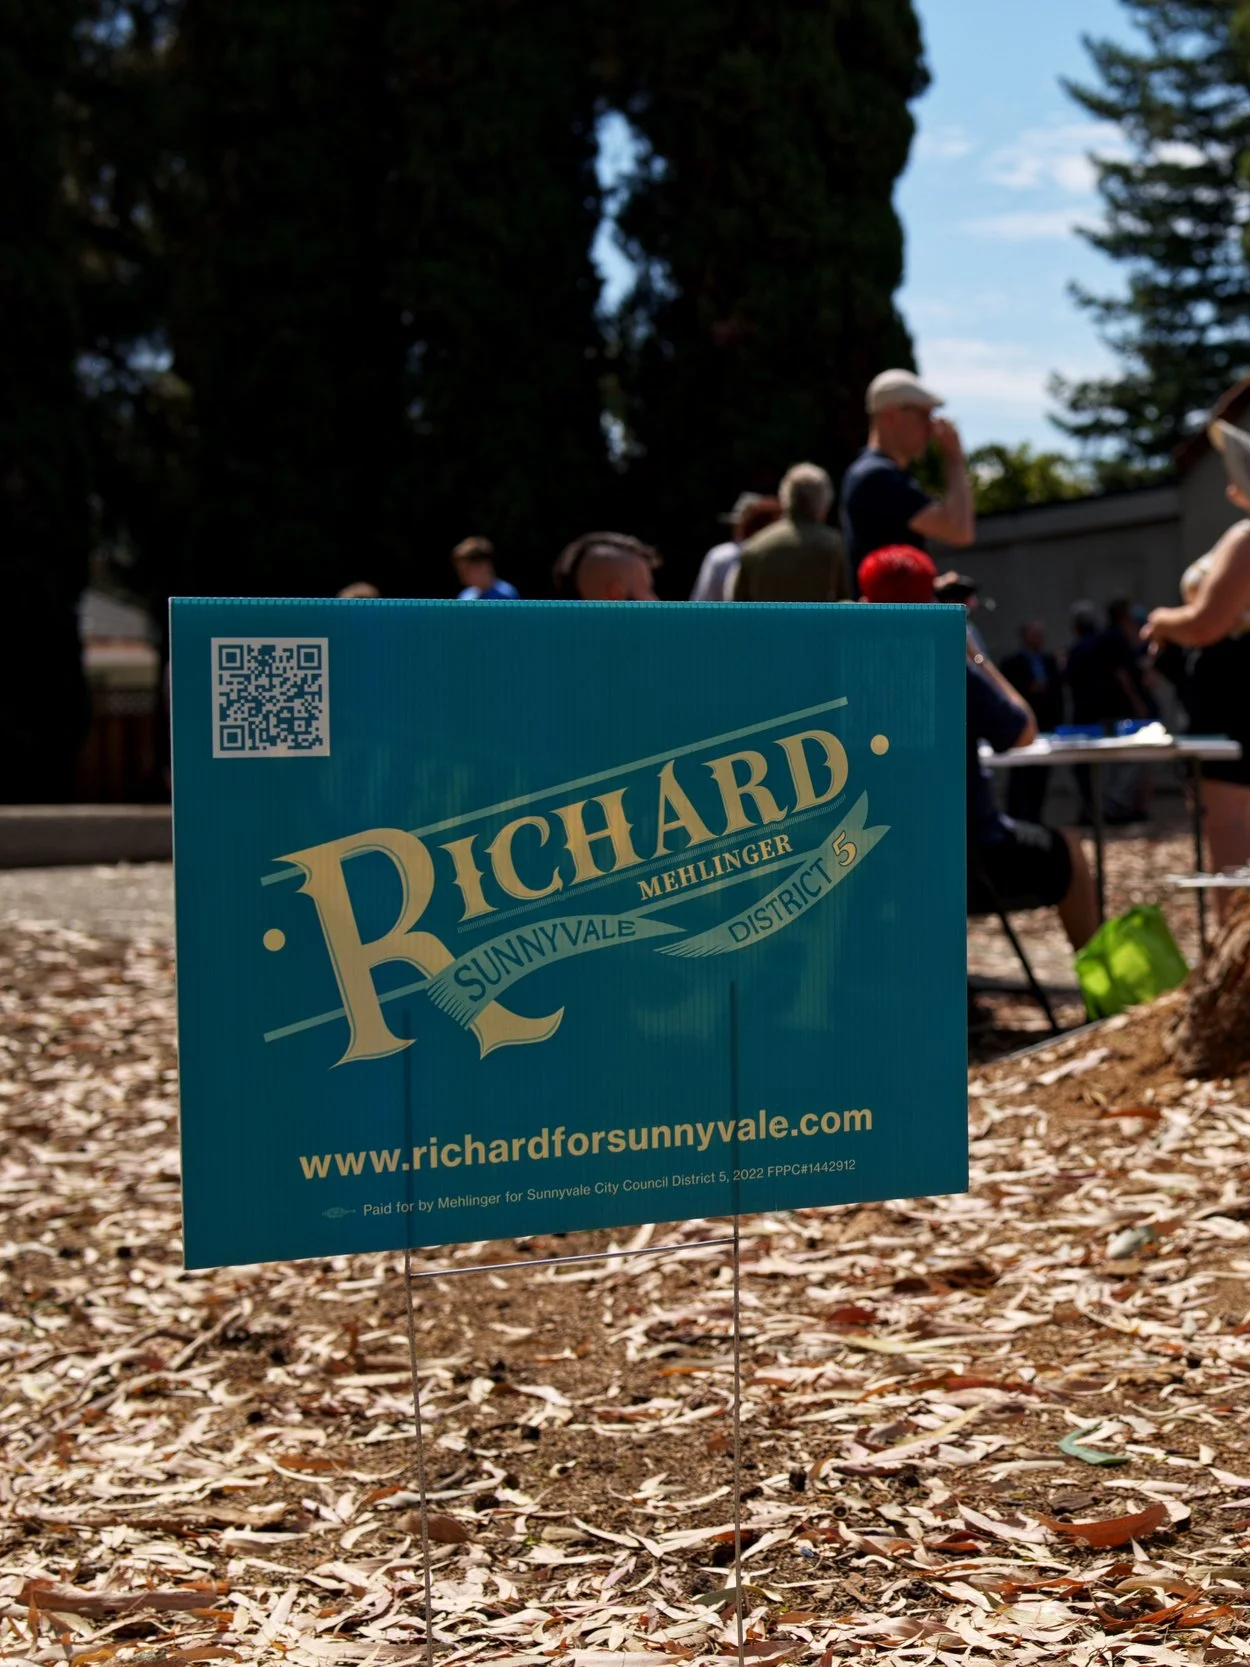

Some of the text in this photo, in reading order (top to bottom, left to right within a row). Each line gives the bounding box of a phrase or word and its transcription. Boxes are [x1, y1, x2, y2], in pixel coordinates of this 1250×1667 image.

[271, 729, 849, 1070] RICHARD
[638, 834, 793, 901] MEHLINGER
[453, 830, 858, 1002] SUNNYVALE DISTRICT 5
[299, 1107, 873, 1180] www.richardforsunnyvale.com
[363, 1202, 392, 1217] Paid
[396, 1201, 415, 1214] for
[418, 1200, 434, 1213] by
[438, 1194, 502, 1209] Mehlinger
[505, 1190, 523, 1204] for
[527, 1184, 591, 1201] Sunnyvale
[594, 1181, 619, 1196] City
[622, 1176, 669, 1192] Council
[672, 1170, 716, 1187] District
[719, 1171, 730, 1184] 5,
[733, 1167, 764, 1181] 2022
[767, 1159, 856, 1178] FPPC#1442912
